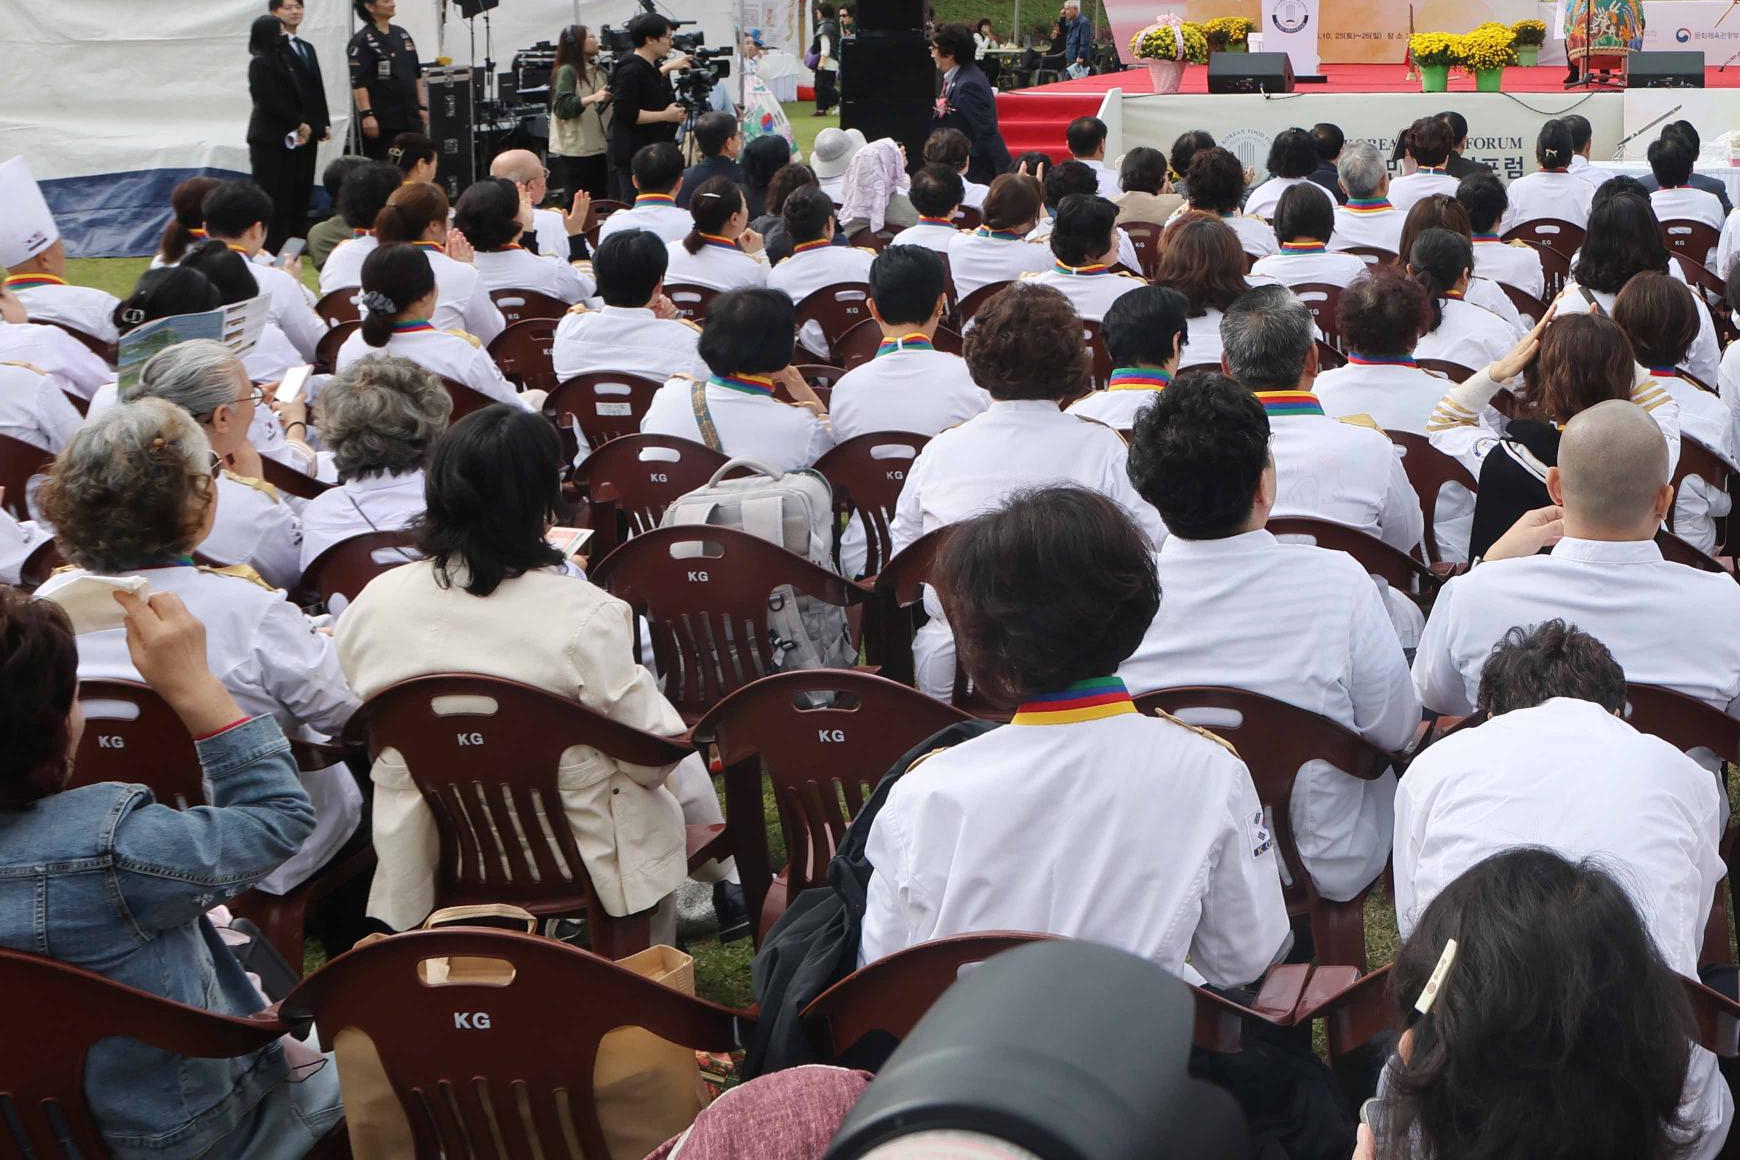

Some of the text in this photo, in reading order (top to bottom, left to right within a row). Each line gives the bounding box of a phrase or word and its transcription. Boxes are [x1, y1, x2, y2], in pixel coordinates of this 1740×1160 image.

[1466, 136, 1523, 150] FORUM
[650, 473, 668, 483] KG
[886, 471, 903, 480] KG
[687, 571, 709, 582] KG
[97, 735, 125, 748] KG
[457, 732, 484, 746] KG
[818, 729, 845, 742] KG
[453, 1012, 491, 1029] KG
